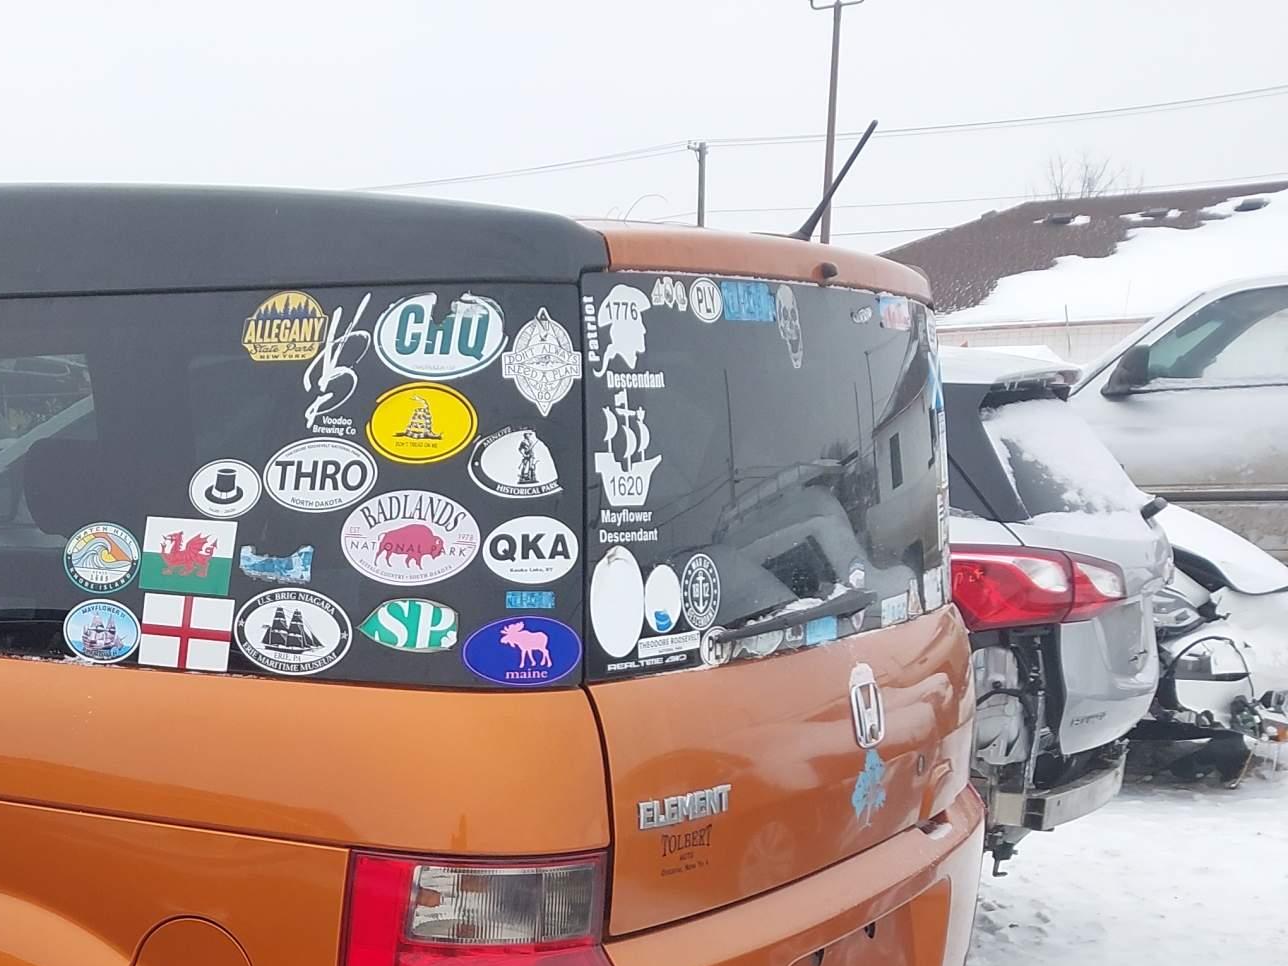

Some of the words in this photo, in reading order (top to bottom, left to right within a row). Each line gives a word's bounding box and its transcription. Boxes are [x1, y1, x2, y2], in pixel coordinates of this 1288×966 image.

[696, 286, 716, 314] PLY
[605, 301, 638, 321] 1776
[244, 317, 325, 343] ALLEGANY
[582, 295, 601, 362] Patriot
[250, 343, 280, 355] State
[283, 343, 313, 354] Park
[553, 365, 578, 380] PLAN
[606, 370, 665, 388] Descendant
[537, 391, 551, 401] GO
[322, 415, 352, 425] Voodoo
[312, 424, 344, 436] Brewing
[345, 425, 356, 435] Co
[274, 459, 368, 492] THRO
[496, 484, 540, 496] HISTORICAL
[540, 481, 560, 494] PARK
[610, 475, 643, 496] 1620
[290, 496, 314, 508] NORTH
[314, 497, 343, 508] DAKOTA
[359, 493, 467, 532] BADLANDS
[601, 509, 653, 527] Mayflower
[75, 526, 108, 541] WATCH
[113, 528, 132, 545] HILL
[599, 528, 658, 543] Descendant
[350, 541, 422, 554] NATONAL
[434, 543, 467, 558] PARK
[489, 533, 571, 562] QKA
[99, 573, 131, 591] ISLAND
[81, 604, 120, 616] MAYFLOWER
[275, 592, 297, 601] BRIG
[298, 592, 337, 616] NIAGARA
[242, 641, 258, 660] ERIE
[257, 655, 299, 672] MARITIME
[300, 652, 338, 672] MUSEUM
[607, 656, 664, 671] REALTIME
[505, 669, 548, 680] maine
[638, 783, 732, 831] ELEMENT
[660, 823, 713, 857] TOLBERT
